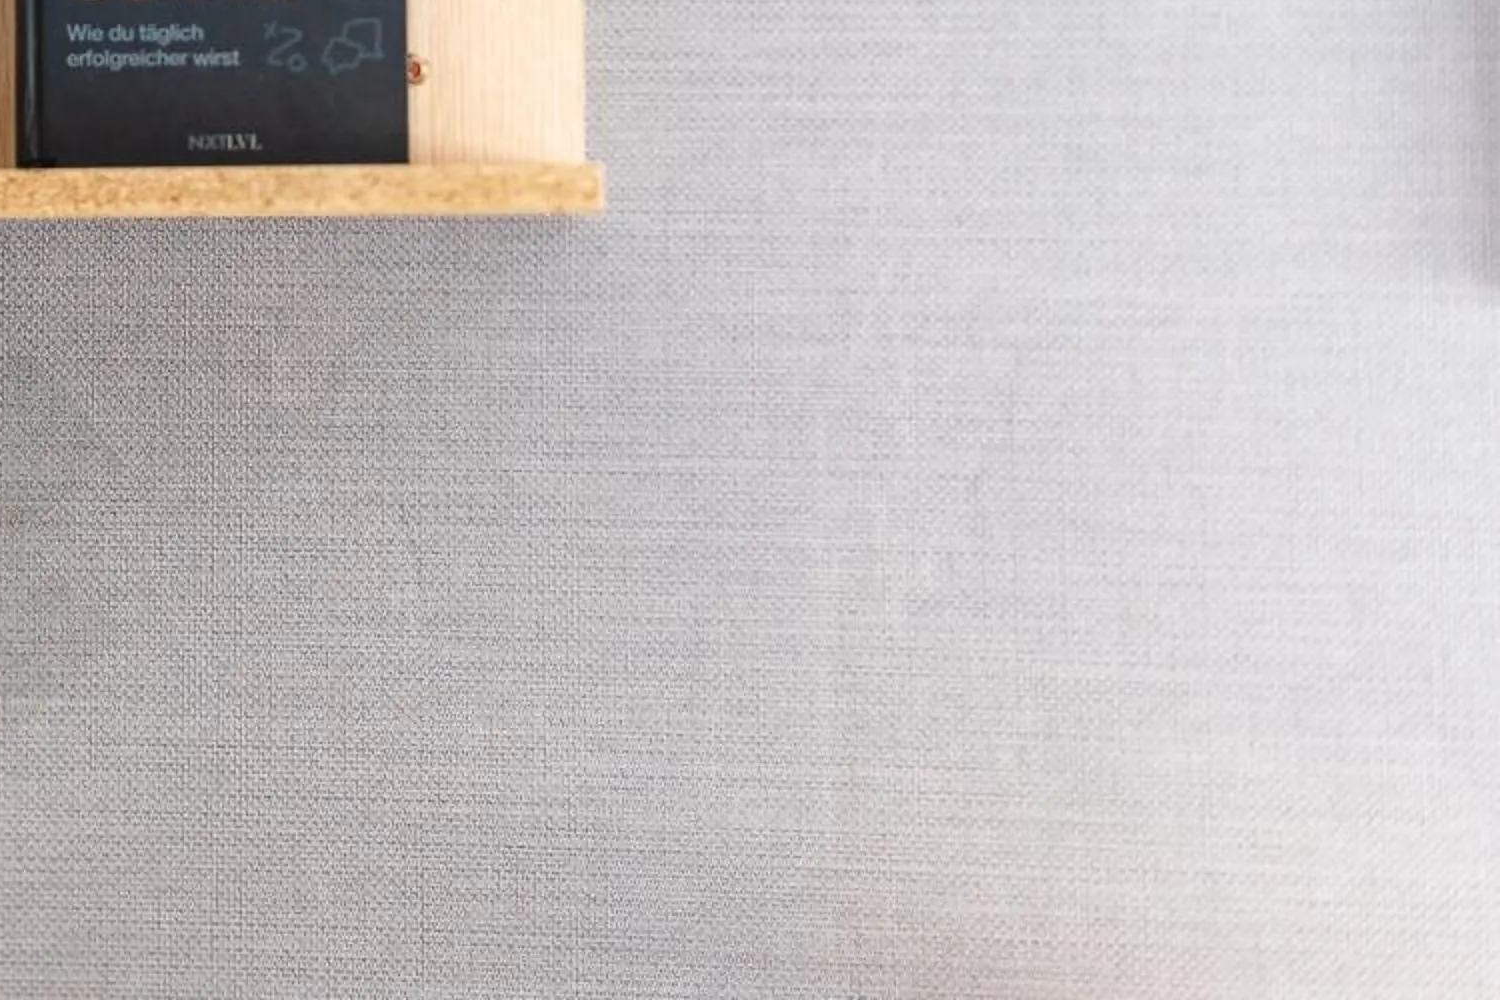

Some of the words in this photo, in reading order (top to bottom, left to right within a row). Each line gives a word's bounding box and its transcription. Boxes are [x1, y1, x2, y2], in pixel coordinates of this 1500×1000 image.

[66, 23, 104, 42] Wie
[108, 23, 134, 42] du
[139, 23, 205, 46] täglich
[66, 49, 188, 72] erfolgreicher
[192, 50, 240, 67] wirst
